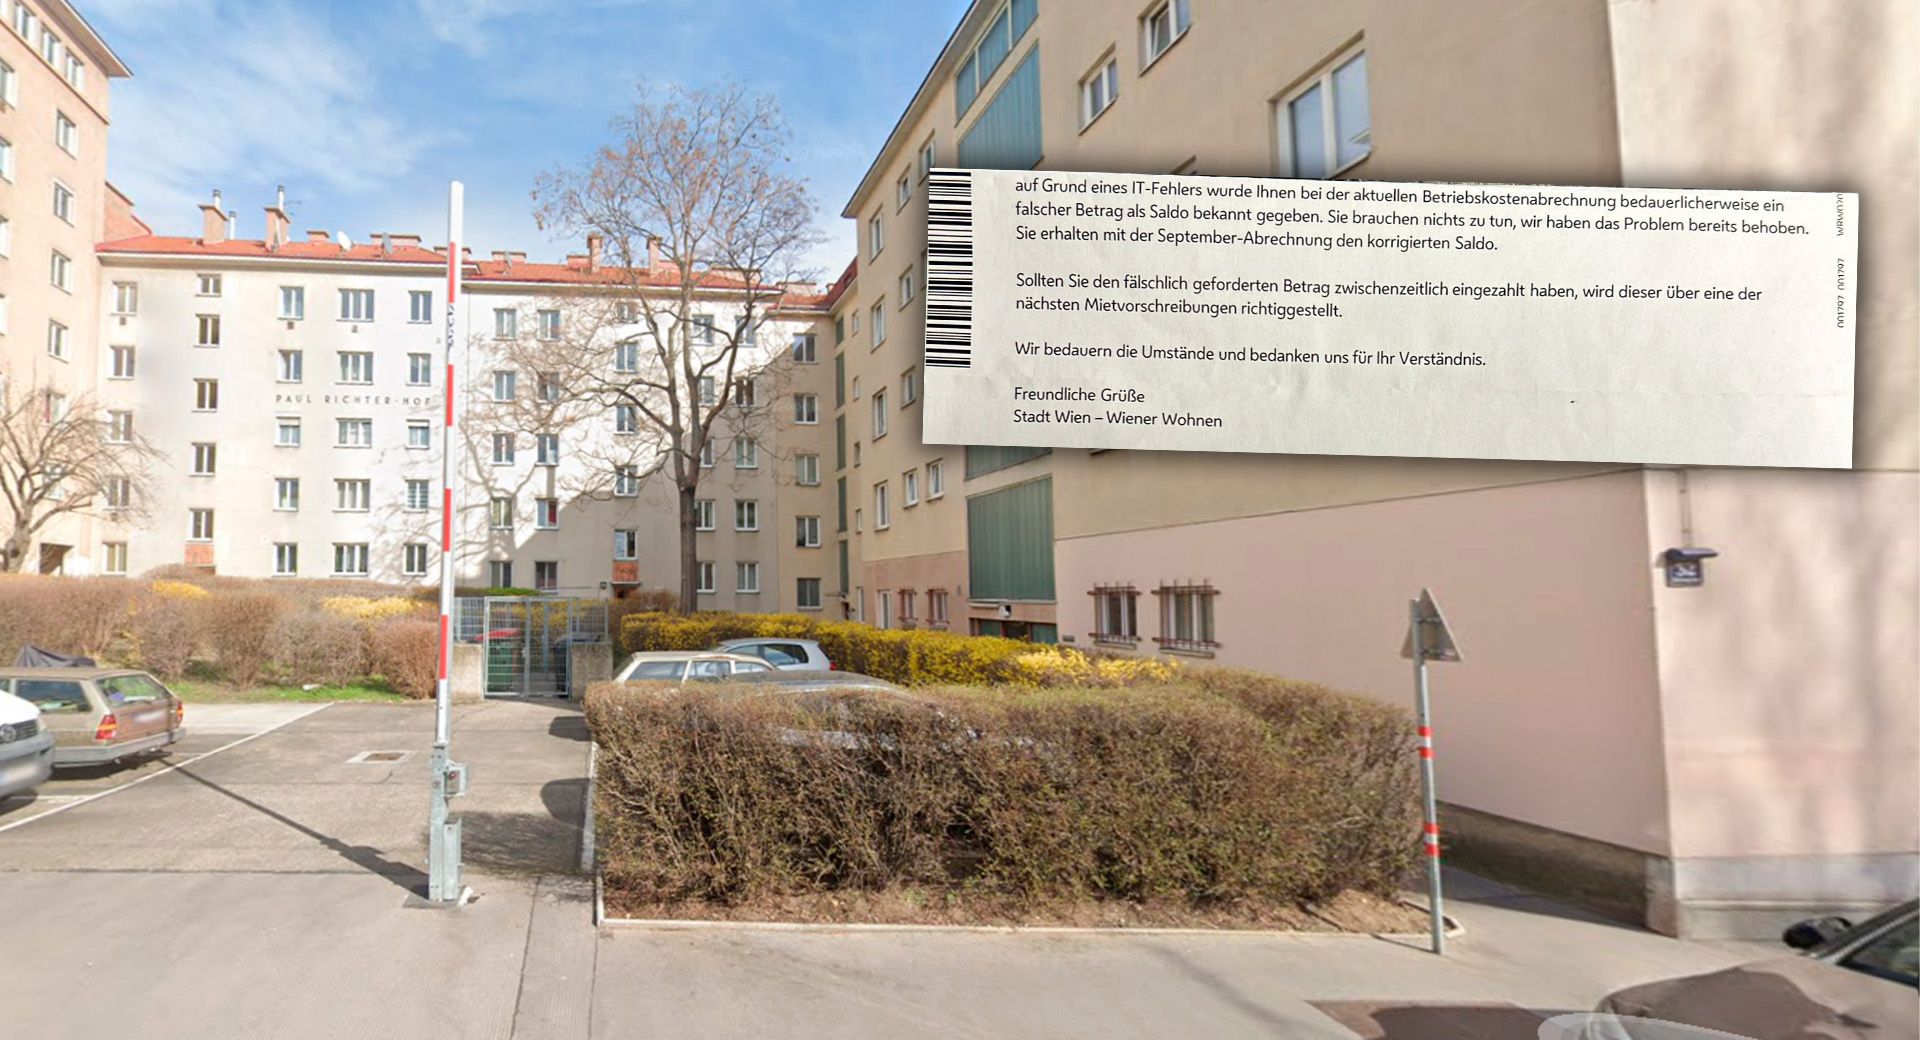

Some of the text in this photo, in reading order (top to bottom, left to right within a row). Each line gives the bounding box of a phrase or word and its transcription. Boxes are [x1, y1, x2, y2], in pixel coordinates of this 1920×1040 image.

[1015, 177, 1785, 212] auf Grund eines IT-Fehlers wurde Ihnen bei der aktuellen Betriebskostenabrechnung bedauerlicherweise ein
[1015, 200, 1809, 235] falscher Betrag als Saldo bekannt gegeben. Sie brauchen nichts zu tun, wir haben das Problem bereits behoben.
[1016, 224, 1498, 253] Sie erhalten mit der September-Abrechnung den korrigierten Saldo.
[1016, 272, 1763, 301] Sollten Sie den fälschlich geforderten Betrag zwischenzeitlich eingezahlt haben, wird dieser über eine der
[1015, 295, 1343, 321] nächsten Mietvorschreibungen richtiggestellt.
[1014, 341, 1486, 366] Wir bedauern die Umstände und bedanken uns für Ihr Verständnis.
[276, 394, 312, 404] PAUL
[1014, 386, 1145, 403] Freundliche Grüße
[1013, 408, 1052, 424] Stadt
[1054, 409, 1091, 424] Wien
[1105, 410, 1159, 426] Wiener
[1161, 412, 1223, 428] Wohnen
